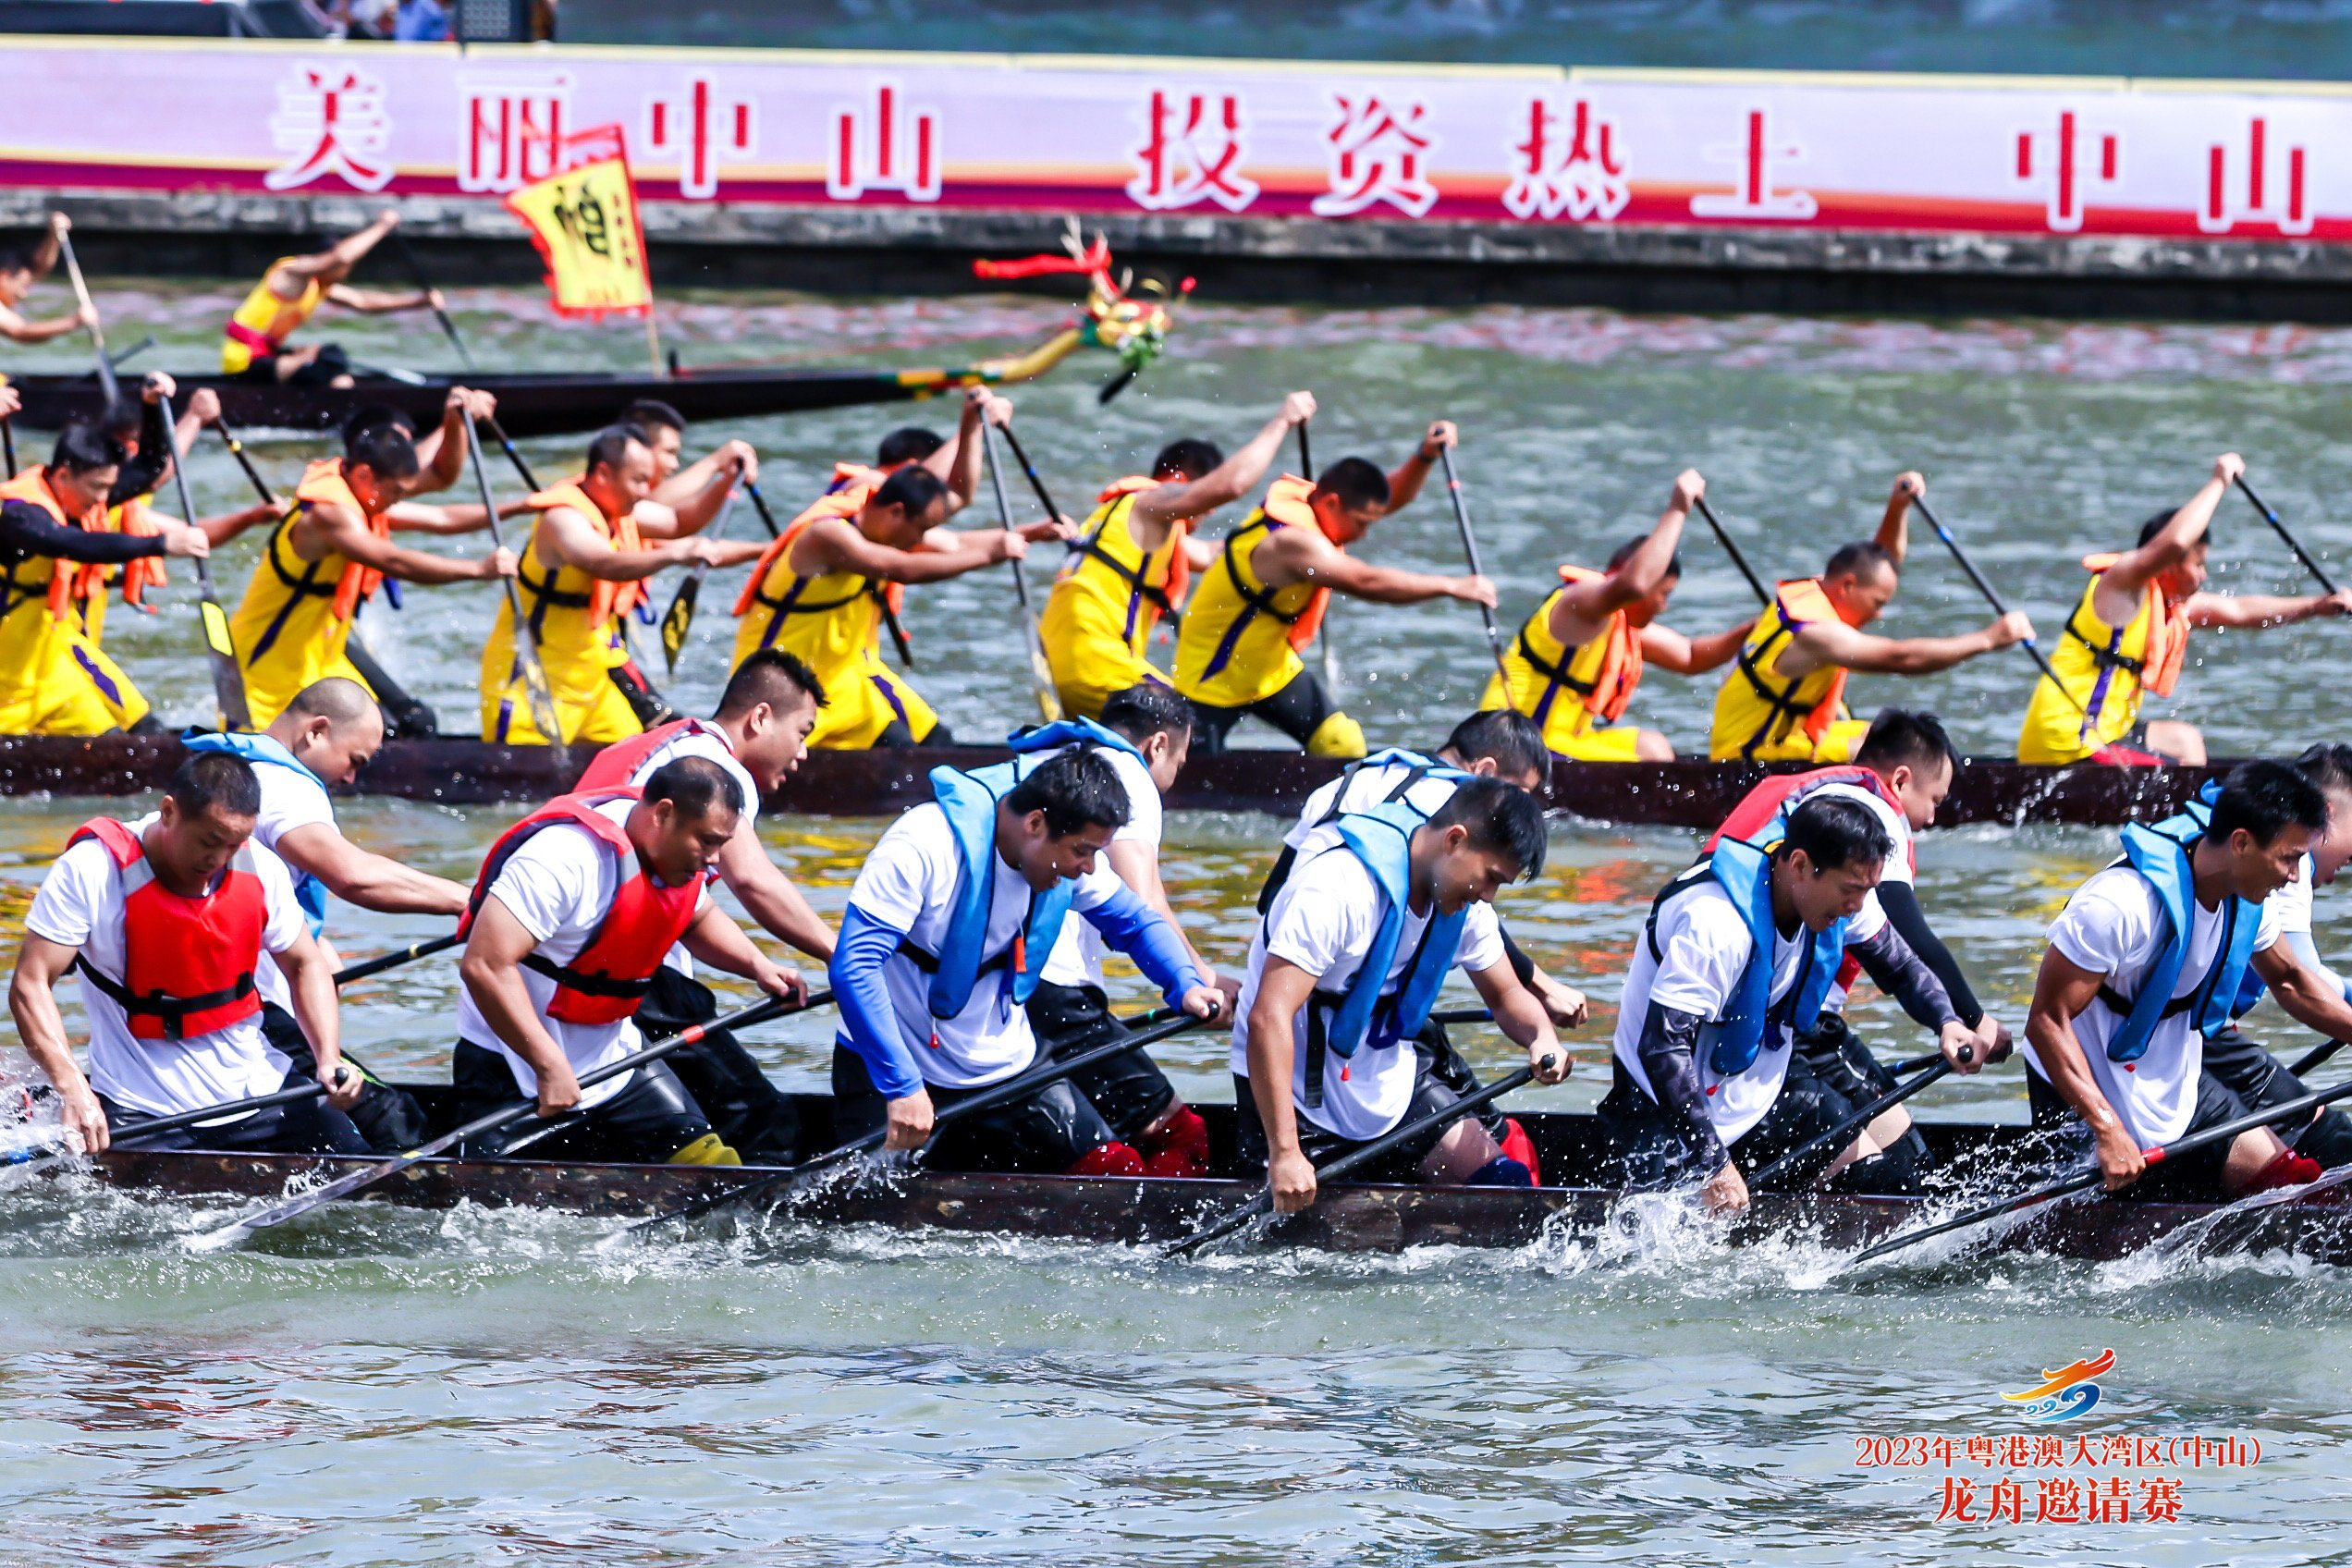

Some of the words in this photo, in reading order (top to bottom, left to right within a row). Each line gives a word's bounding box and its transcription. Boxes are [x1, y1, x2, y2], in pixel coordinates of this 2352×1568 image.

[263, 62, 942, 202] 美丽中山
[1125, 85, 1818, 221] 投资热土
[2011, 105, 2316, 235] 中山
